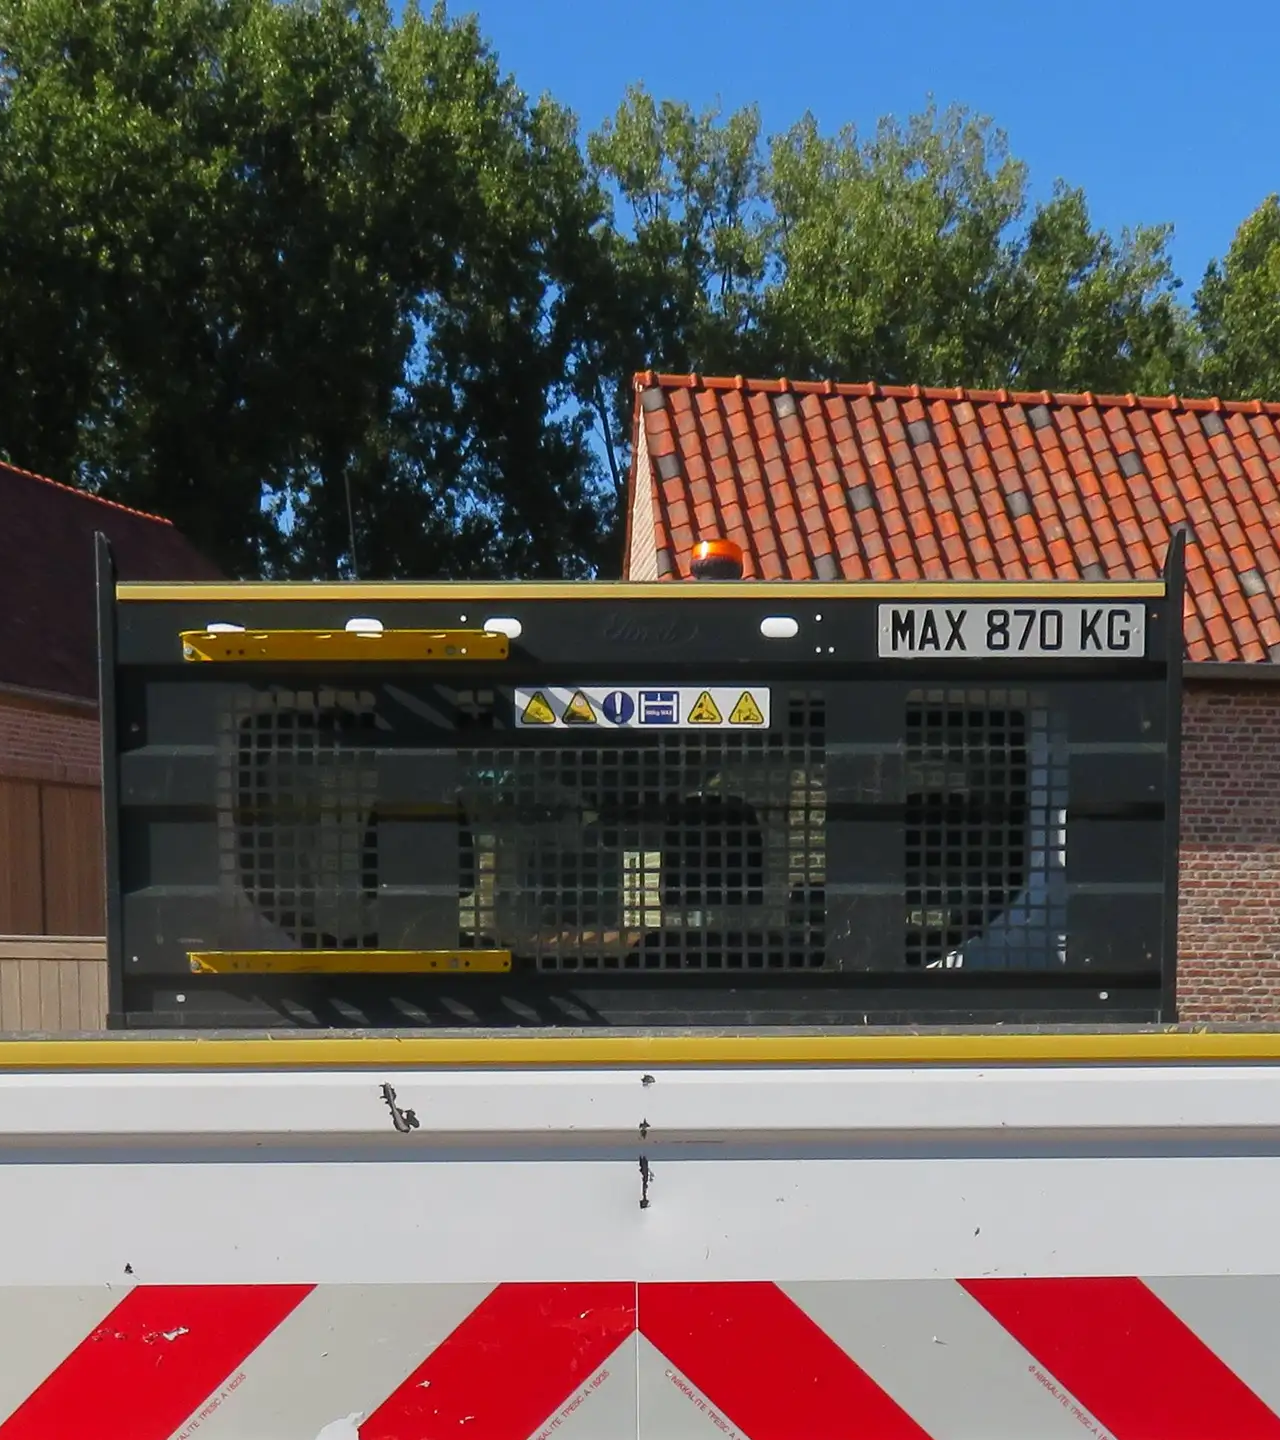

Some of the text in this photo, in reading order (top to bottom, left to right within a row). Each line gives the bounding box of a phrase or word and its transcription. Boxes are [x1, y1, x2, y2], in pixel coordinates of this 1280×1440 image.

[891, 609, 1130, 651] MAX 870 KG
